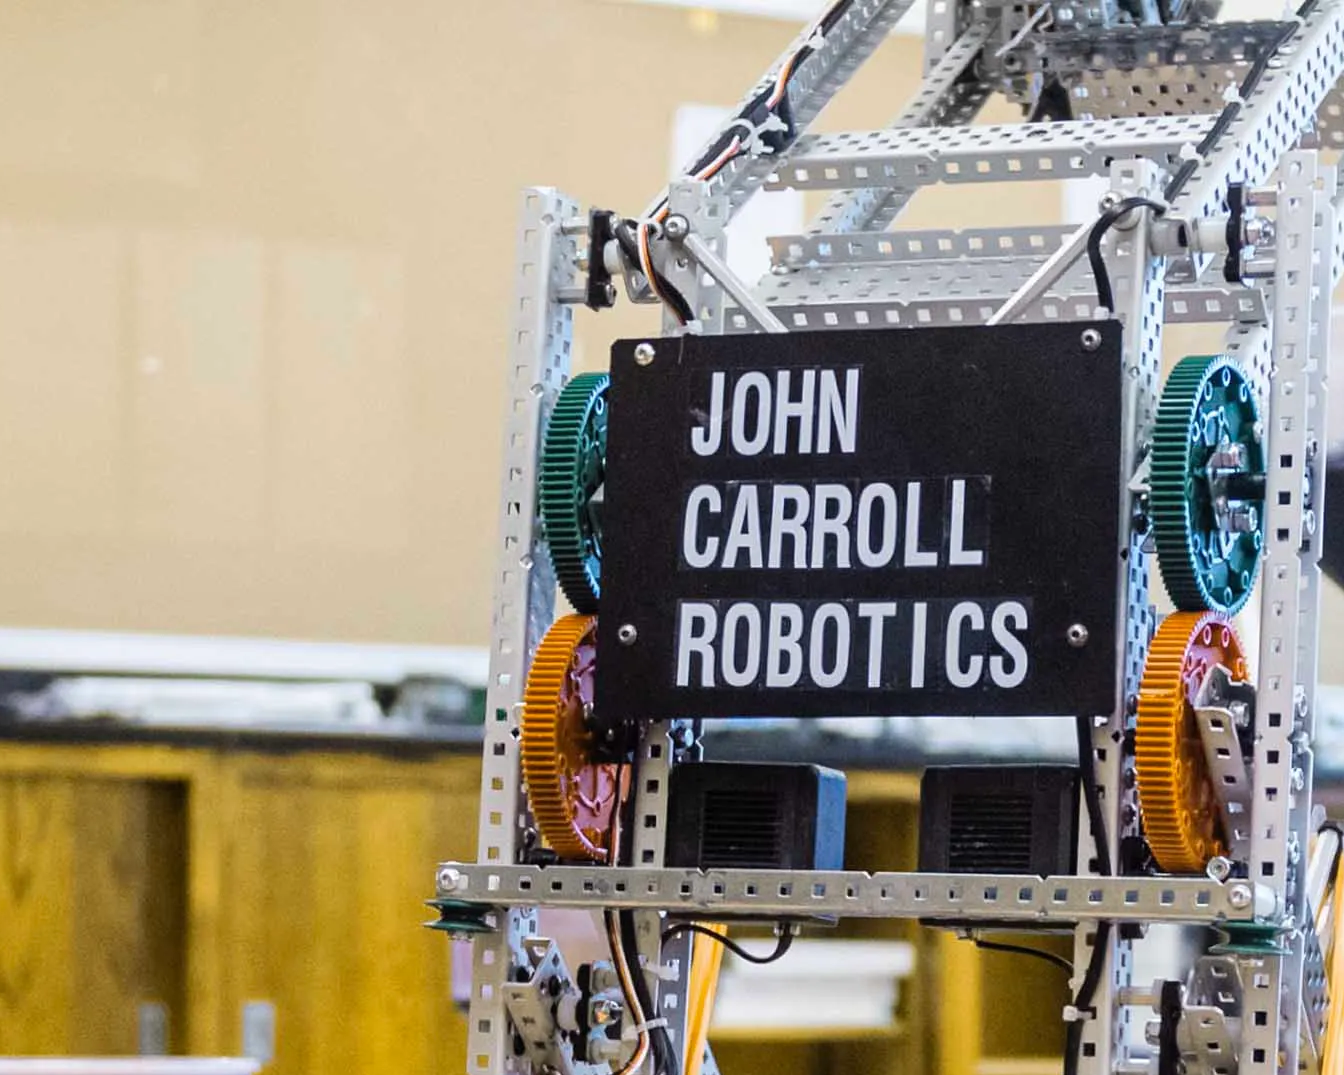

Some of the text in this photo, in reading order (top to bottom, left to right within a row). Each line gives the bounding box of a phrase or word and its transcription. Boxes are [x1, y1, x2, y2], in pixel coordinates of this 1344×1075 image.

[691, 368, 860, 457] JOHN
[682, 479, 984, 569] CARROLL
[675, 601, 1029, 689] ROBOTICS
